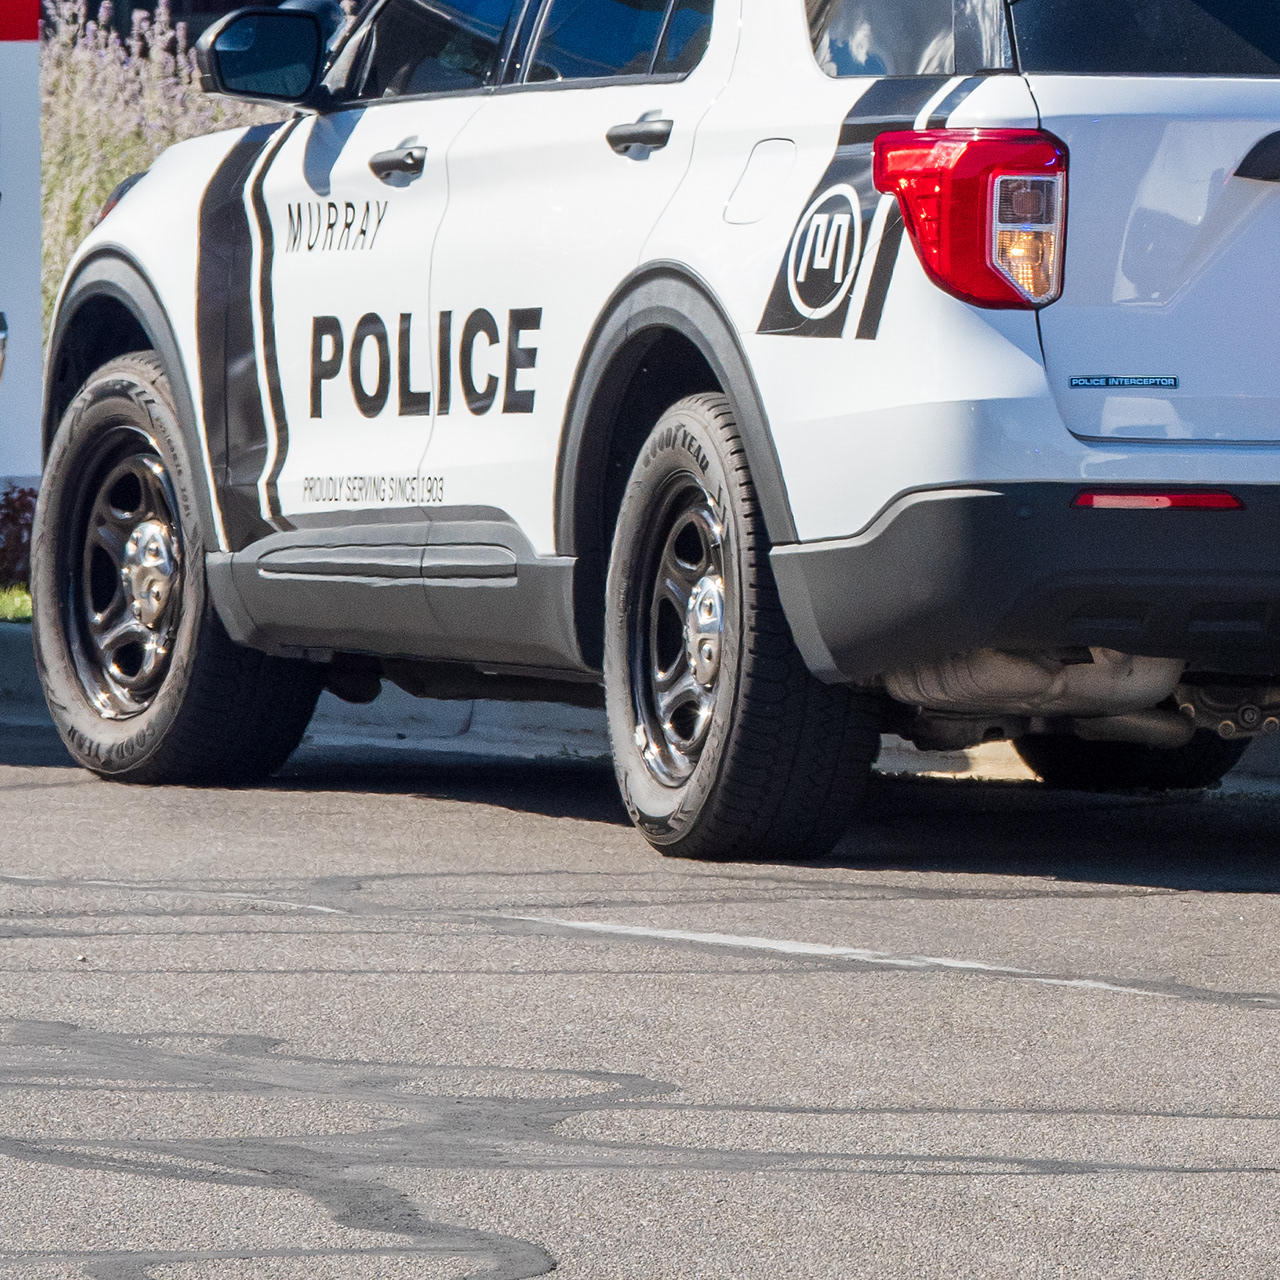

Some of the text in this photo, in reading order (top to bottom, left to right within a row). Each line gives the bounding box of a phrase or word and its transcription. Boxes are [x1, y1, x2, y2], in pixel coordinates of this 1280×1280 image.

[286, 200, 388, 253] MURRAY
[310, 307, 543, 419] POLICE
[1071, 377, 1175, 386] POLICE INTERCEPTOR
[303, 476, 444, 503] PROUDLY SERVING SINCE 1903
